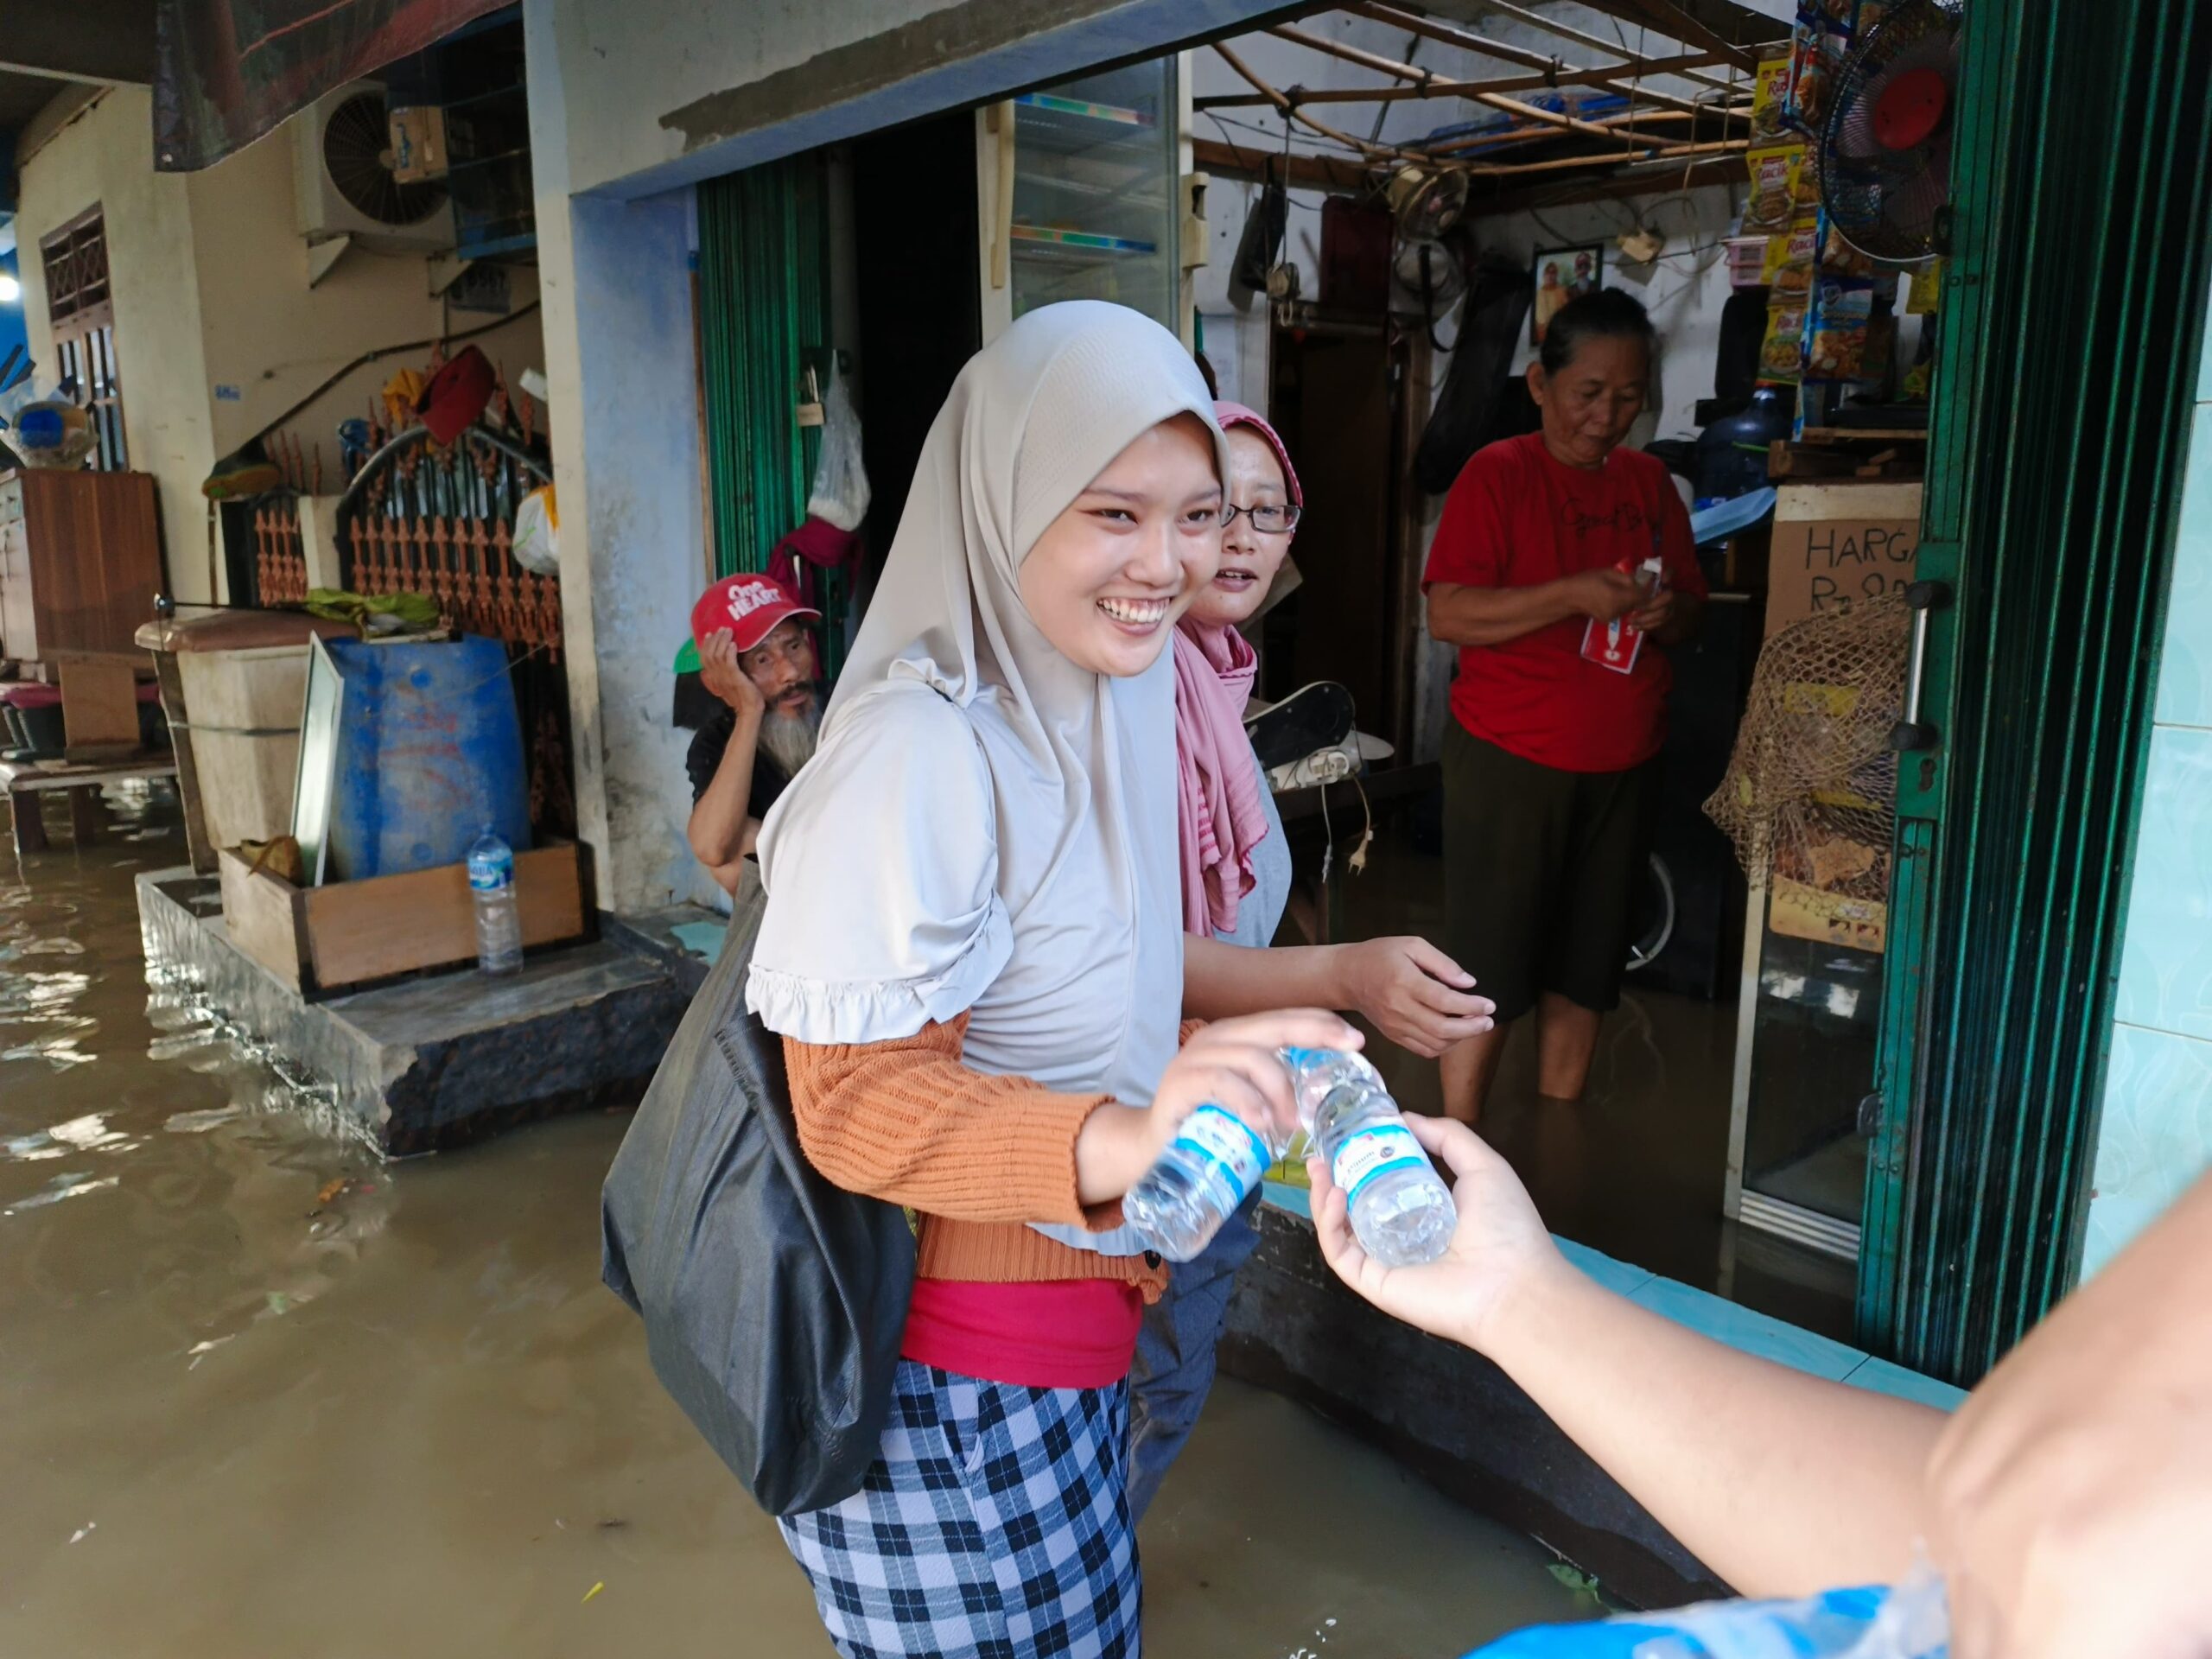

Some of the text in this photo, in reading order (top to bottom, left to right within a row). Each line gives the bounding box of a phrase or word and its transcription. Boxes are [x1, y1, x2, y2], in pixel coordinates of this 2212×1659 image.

[728, 581, 764, 601] One
[728, 588, 781, 620] HEART
[469, 864, 493, 877] QUA
